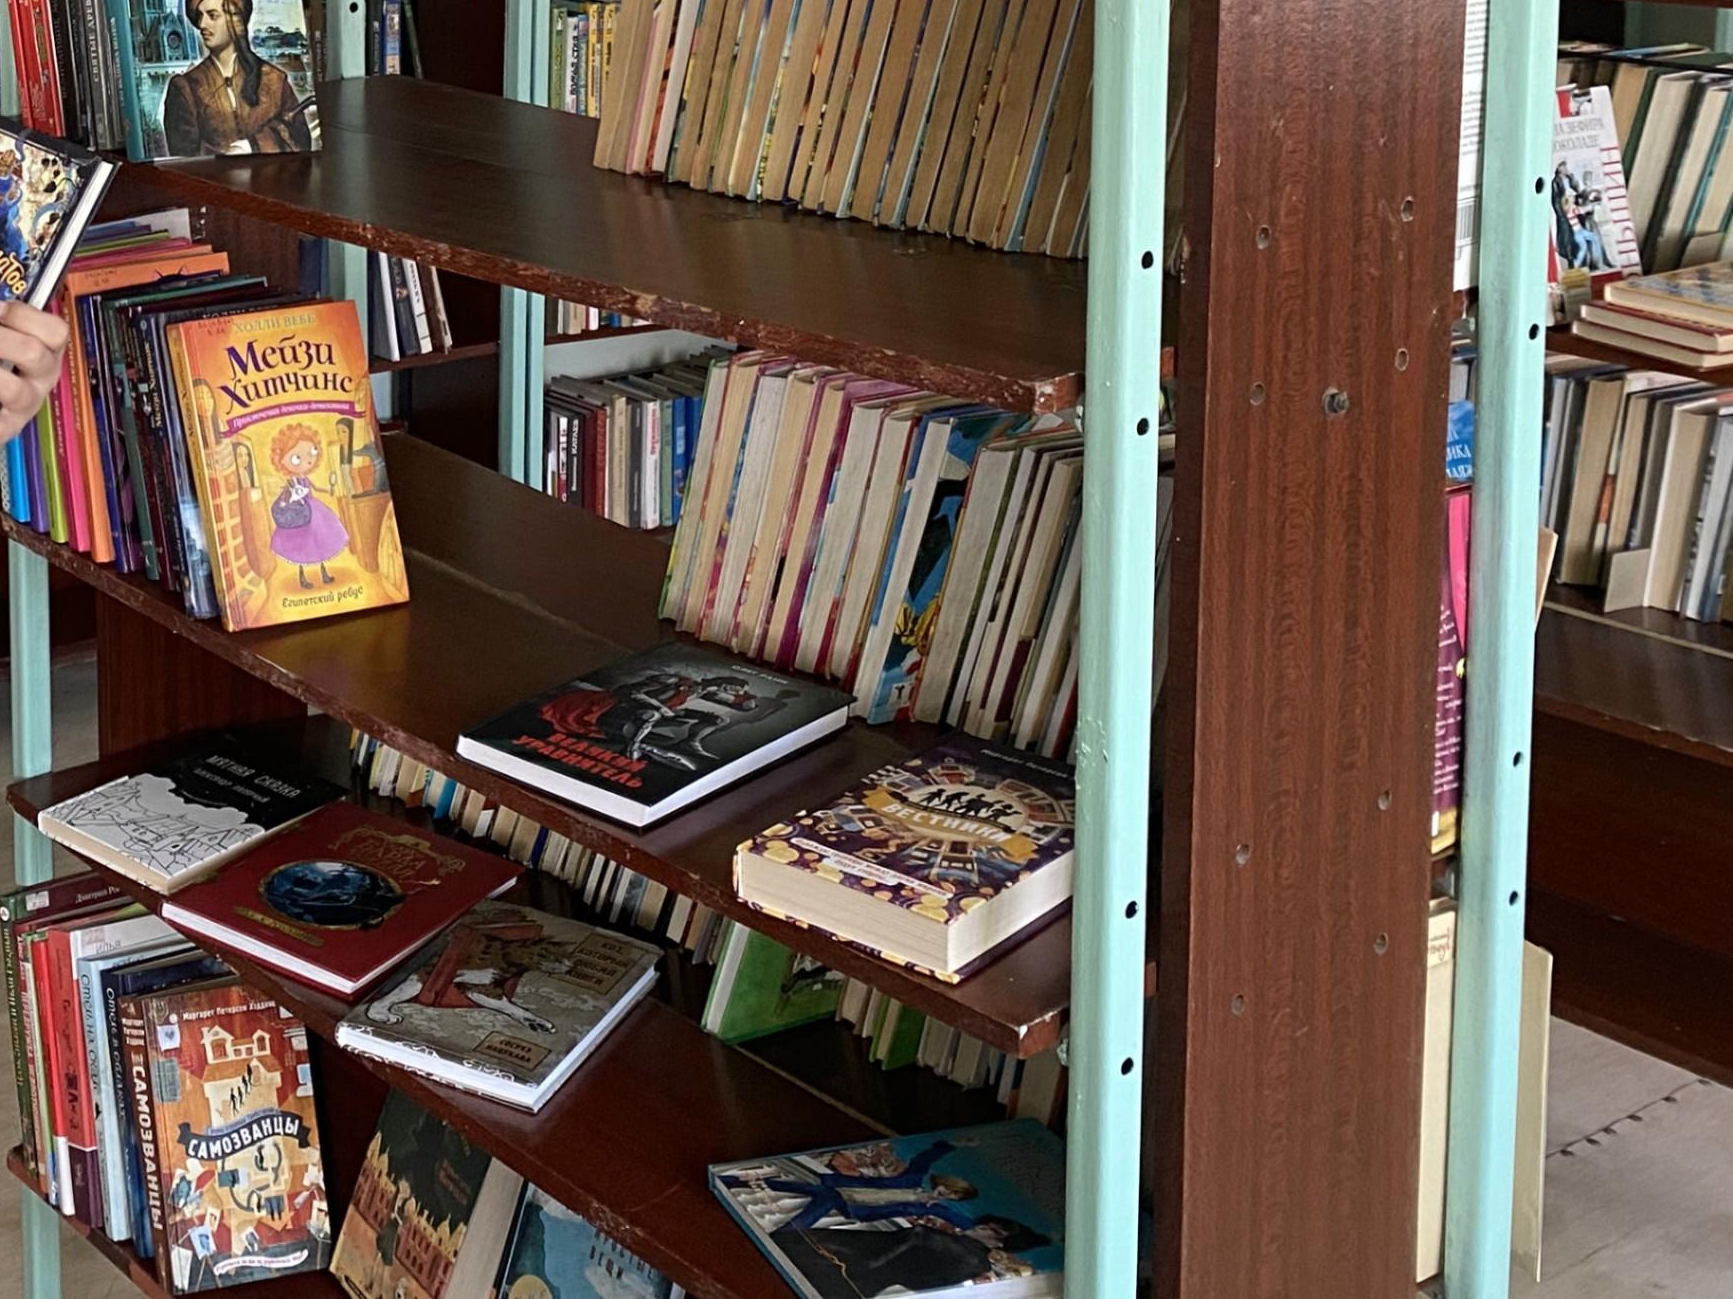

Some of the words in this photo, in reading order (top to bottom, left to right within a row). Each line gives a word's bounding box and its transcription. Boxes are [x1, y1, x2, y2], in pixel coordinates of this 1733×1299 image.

[225, 334, 336, 380] Мейзи
[218, 372, 353, 416] Хитчинс
[281, 592, 334, 608] Египетский
[336, 586, 364, 602] ребус
[880, 803, 1012, 841] ВЕСТНИКИ
[105, 987, 119, 1035] Отель
[182, 1008, 215, 1021] Маргарет
[216, 1004, 247, 1016] Петерсон
[132, 1065, 163, 1231] САМОЗВАНЦЫ
[188, 1118, 300, 1160] САМОЗВАНЦЫ
